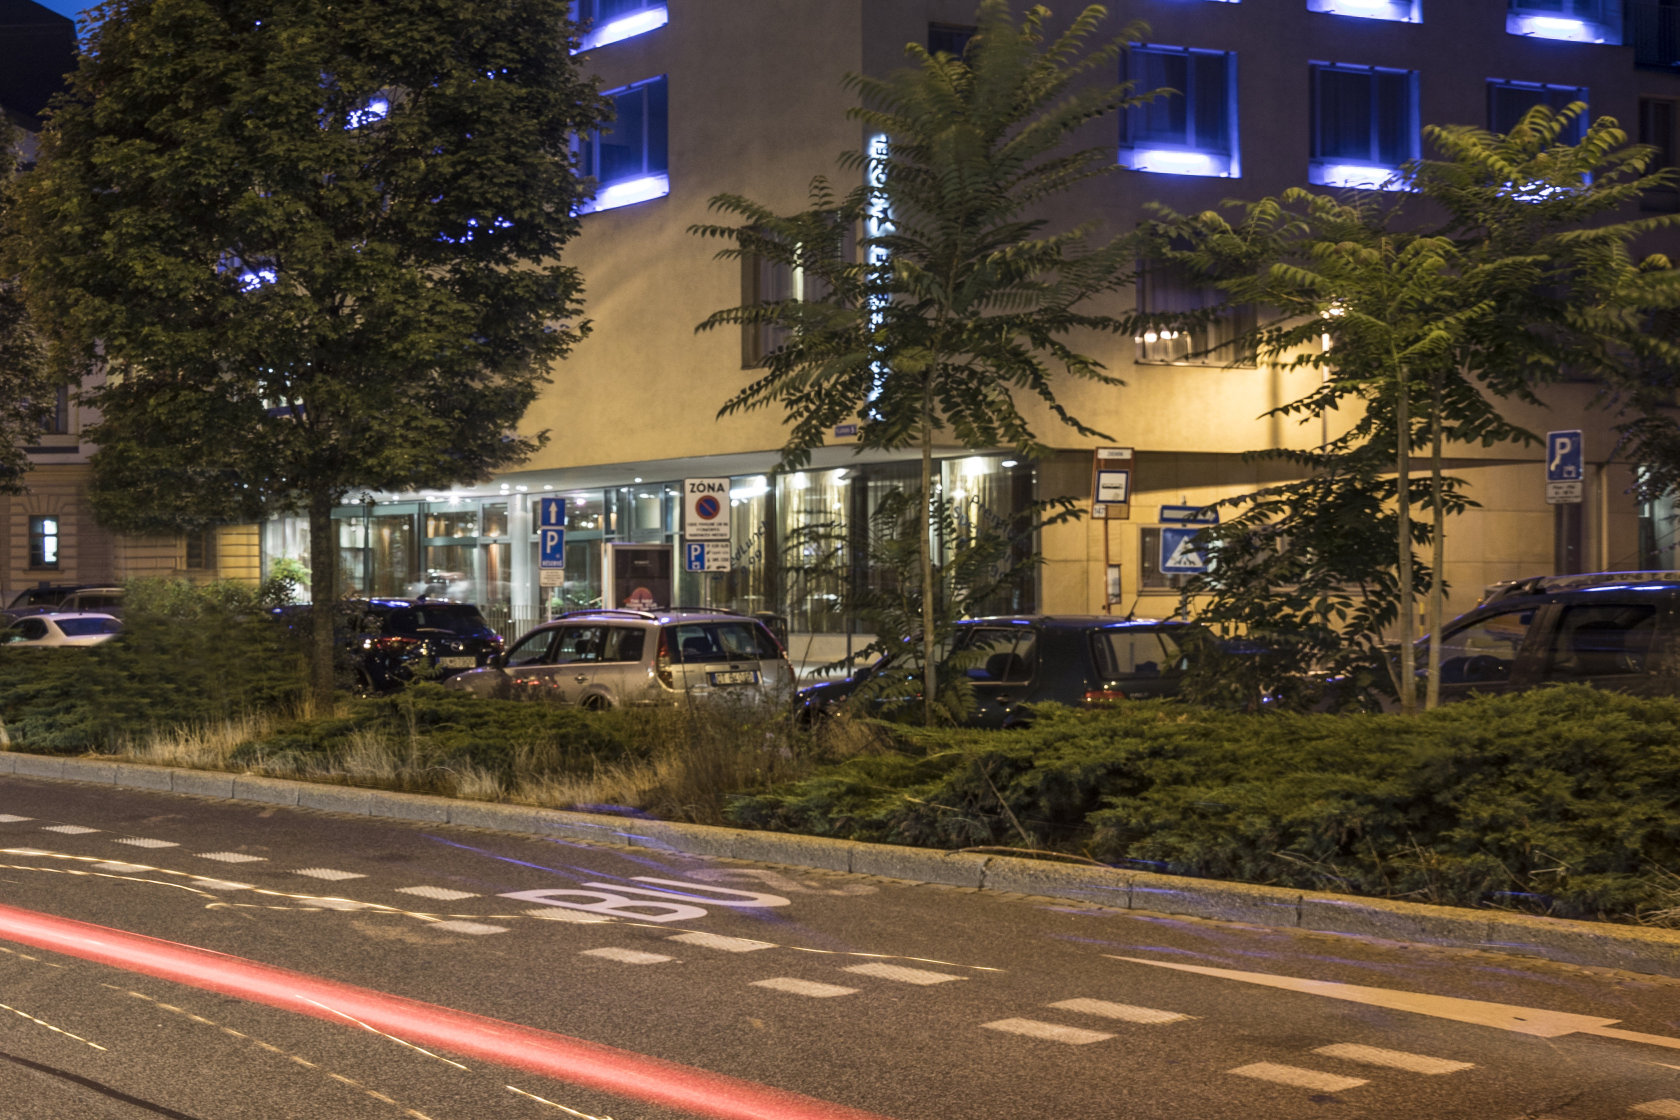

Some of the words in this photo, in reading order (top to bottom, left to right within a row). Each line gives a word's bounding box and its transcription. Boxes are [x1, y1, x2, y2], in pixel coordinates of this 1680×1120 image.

[689, 480, 726, 493] ZÓNA
[546, 530, 559, 554] P
[690, 544, 701, 561] P
[499, 867, 879, 924] BUS
